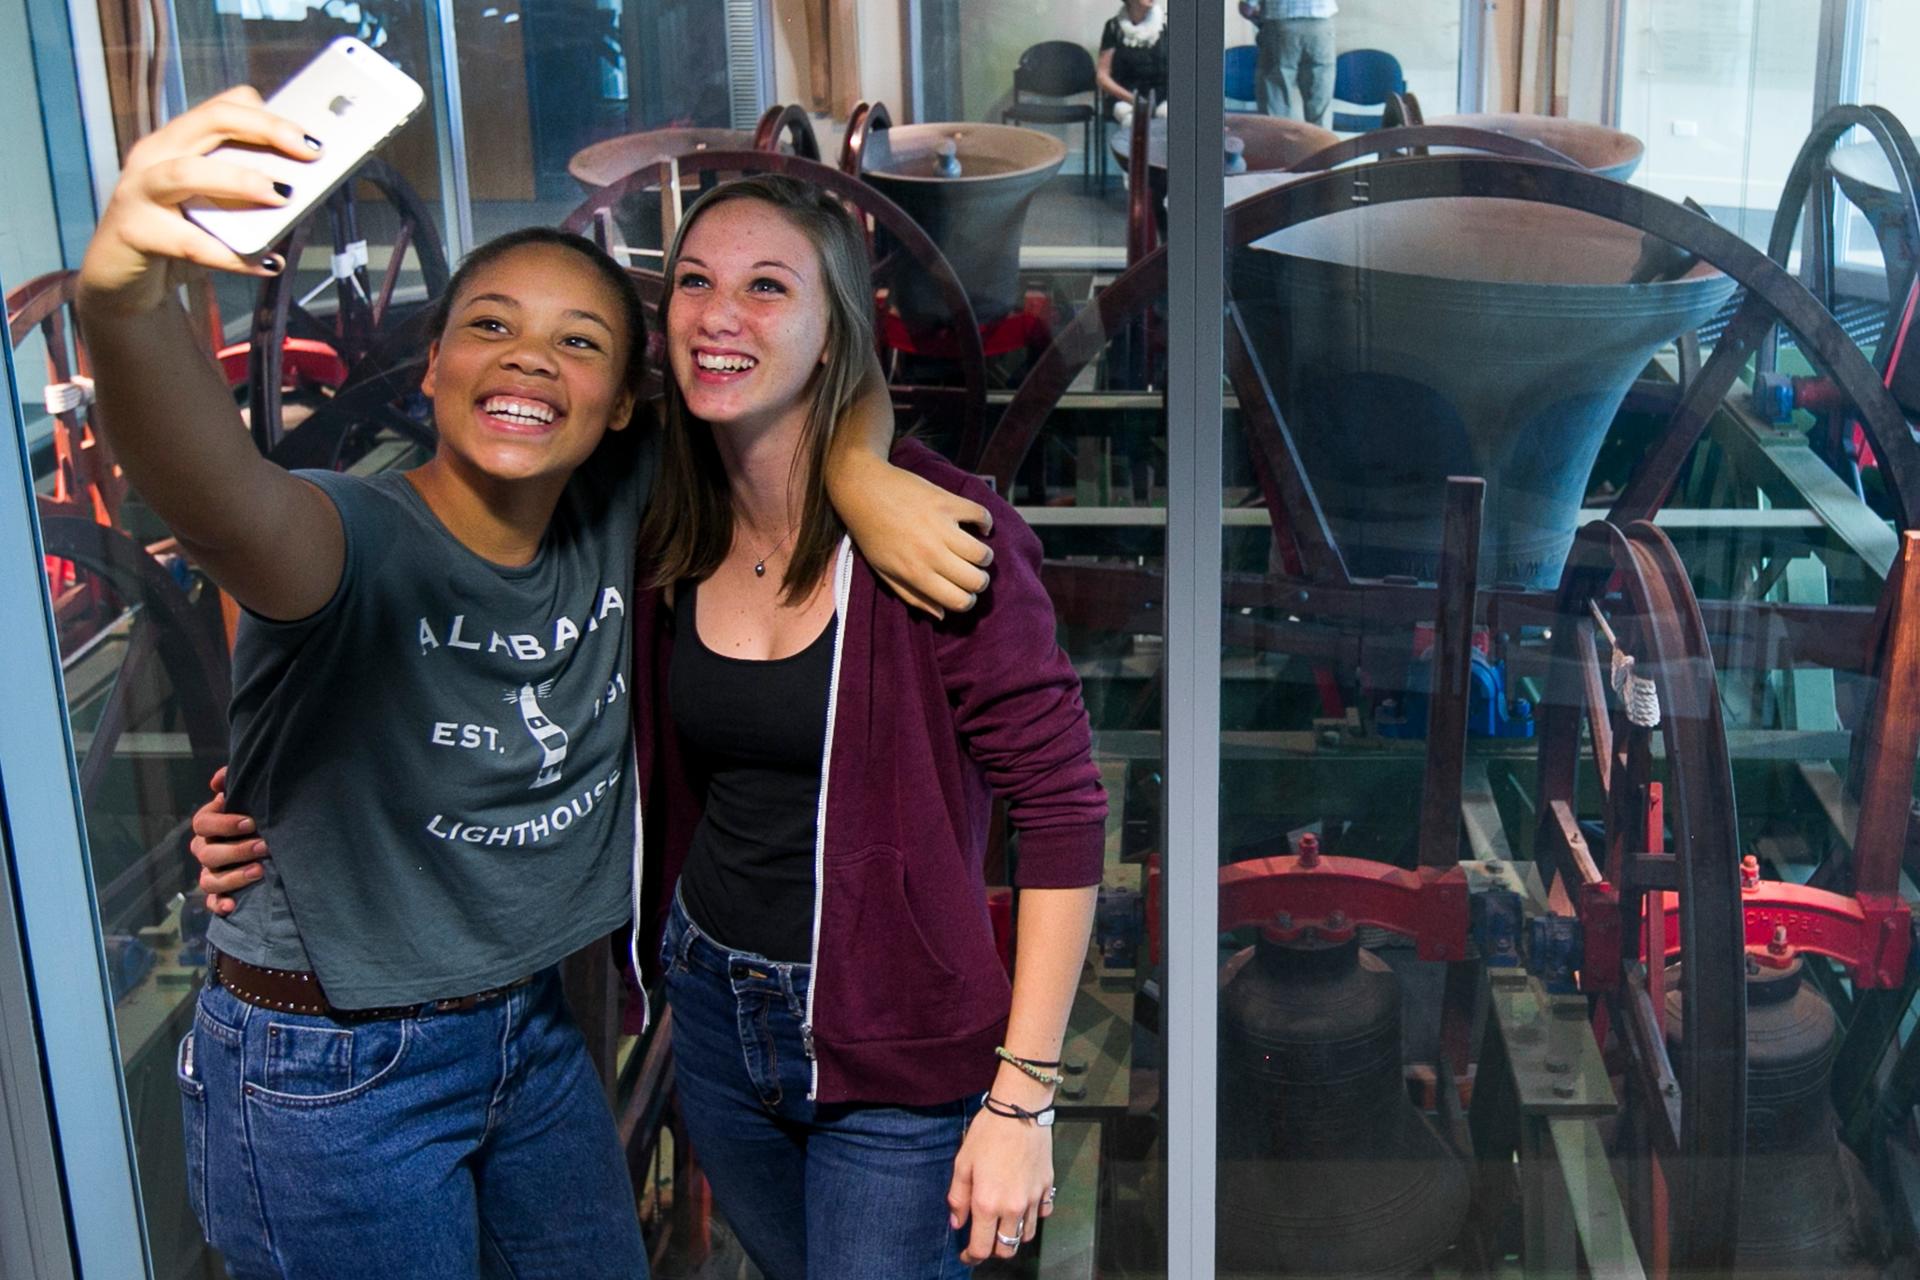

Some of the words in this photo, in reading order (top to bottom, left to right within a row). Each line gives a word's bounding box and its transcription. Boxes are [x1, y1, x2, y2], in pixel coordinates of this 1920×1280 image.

[418, 586, 625, 660] ALABAA
[431, 722, 505, 753] EST.
[1745, 910, 1824, 934] CHAPEL
